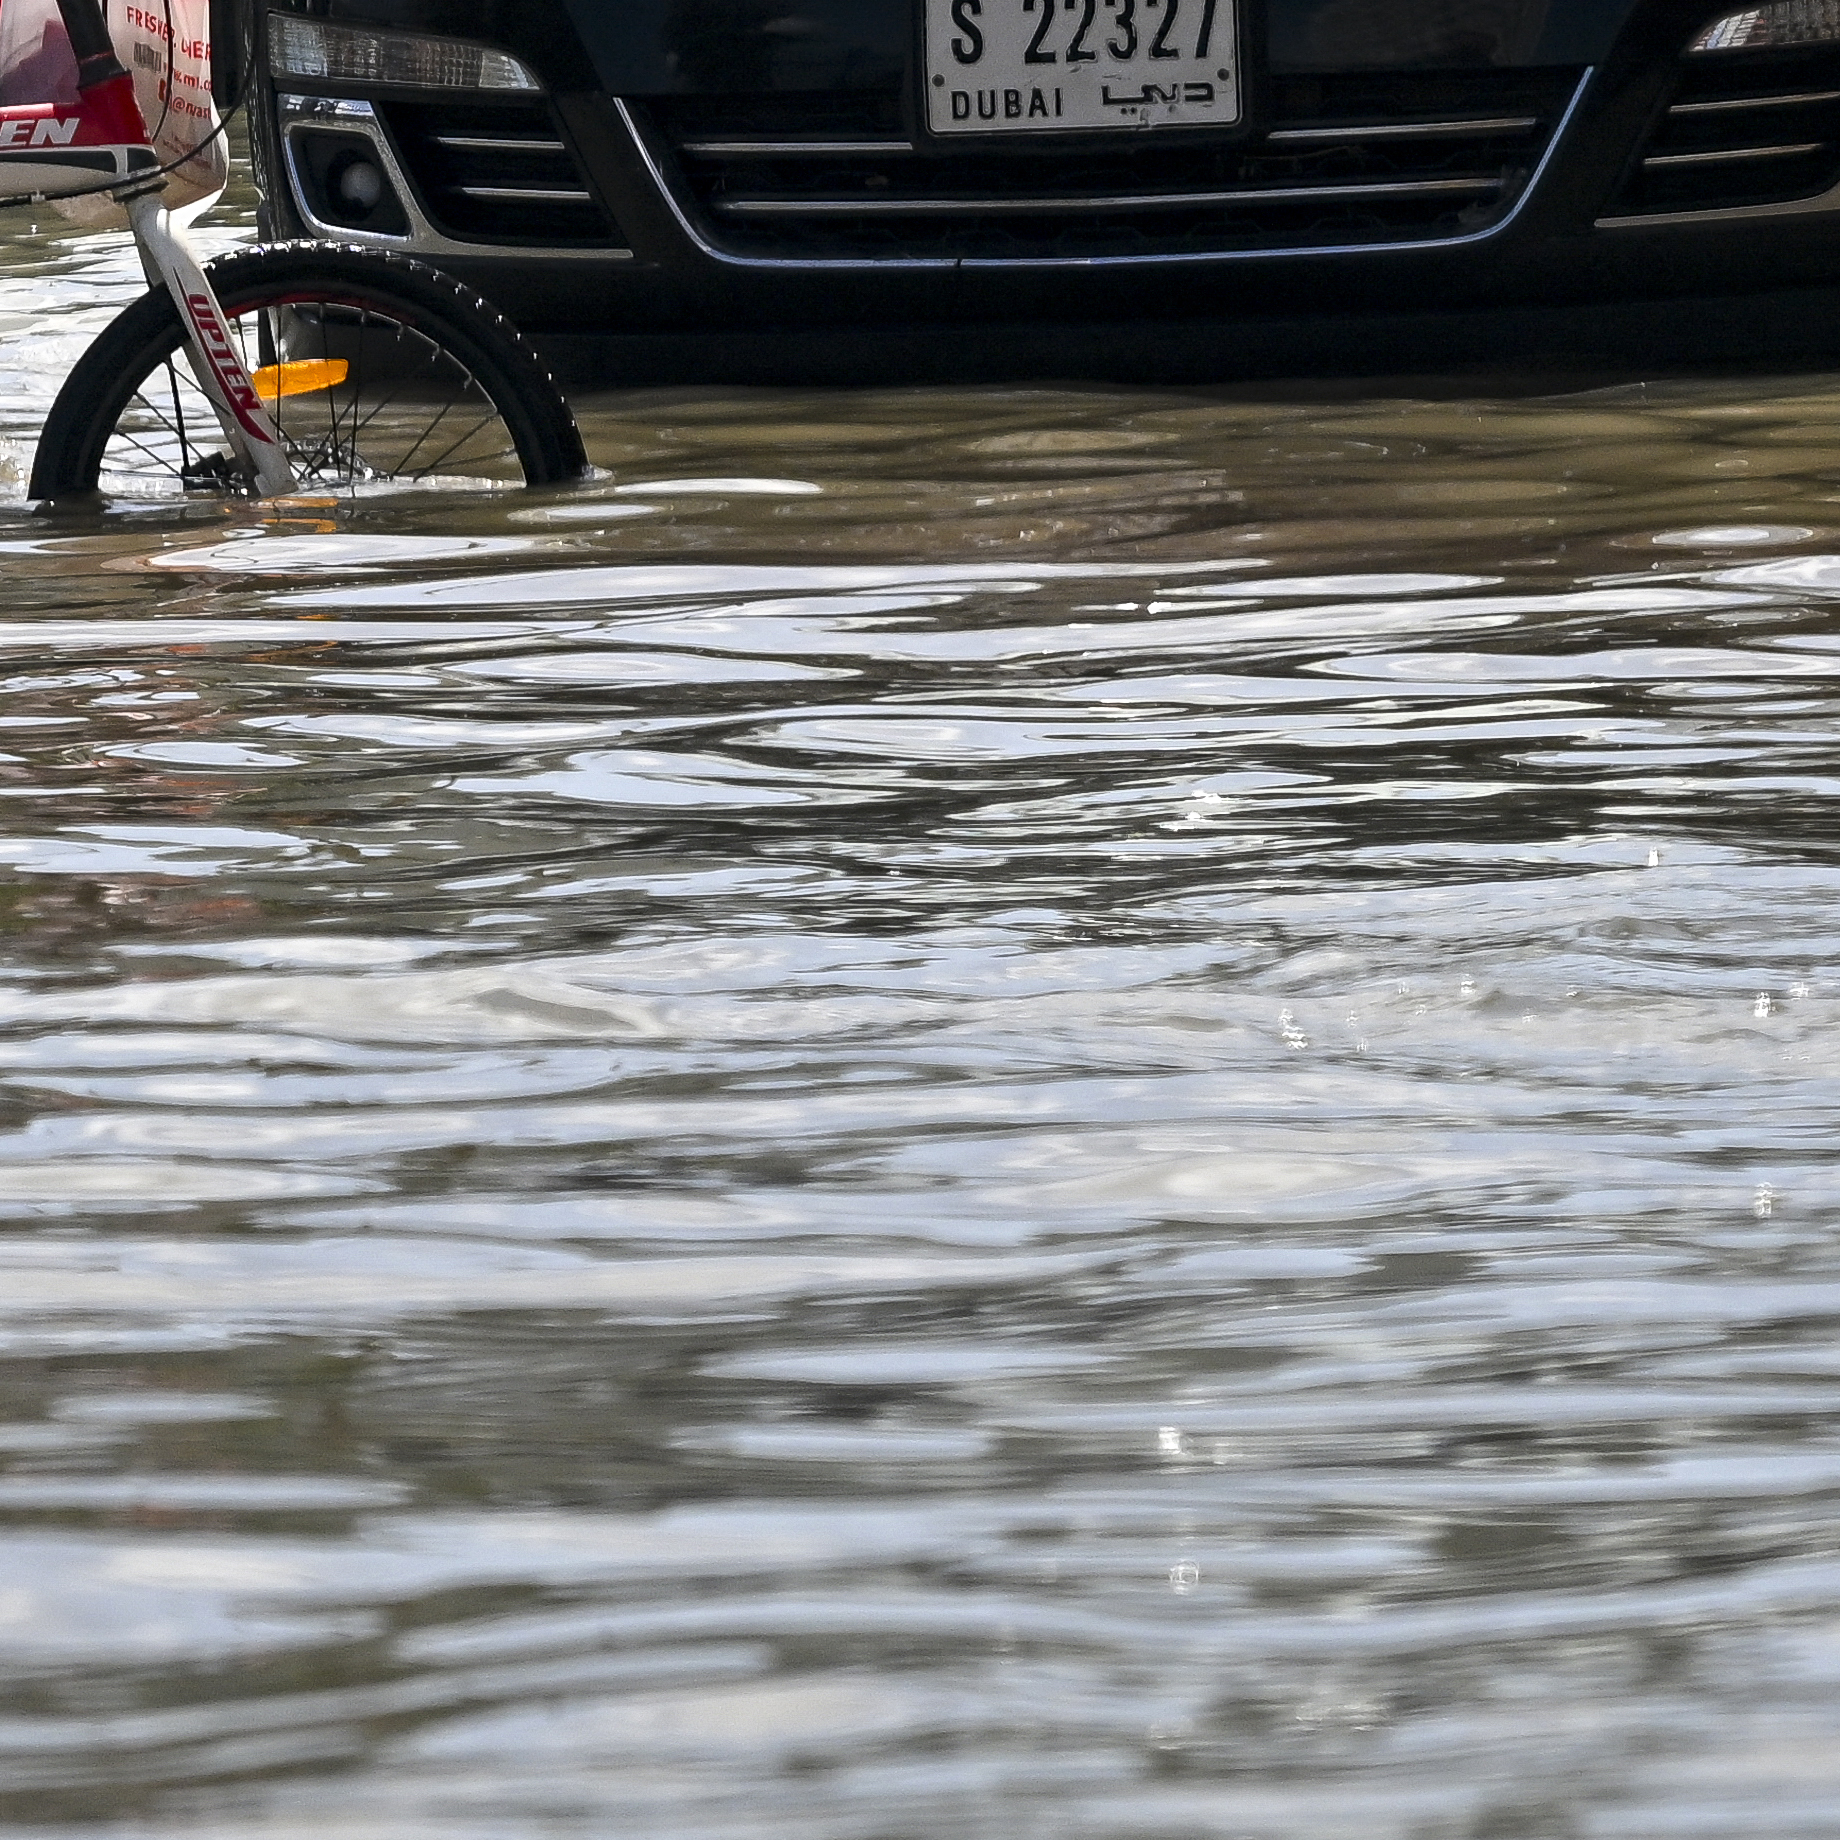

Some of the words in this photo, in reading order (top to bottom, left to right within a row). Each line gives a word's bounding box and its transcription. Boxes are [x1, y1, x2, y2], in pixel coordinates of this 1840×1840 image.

[950, 86, 1064, 121] DUBAI
[1101, 81, 1215, 115] دبي
[188, 293, 263, 410] UPTEN
